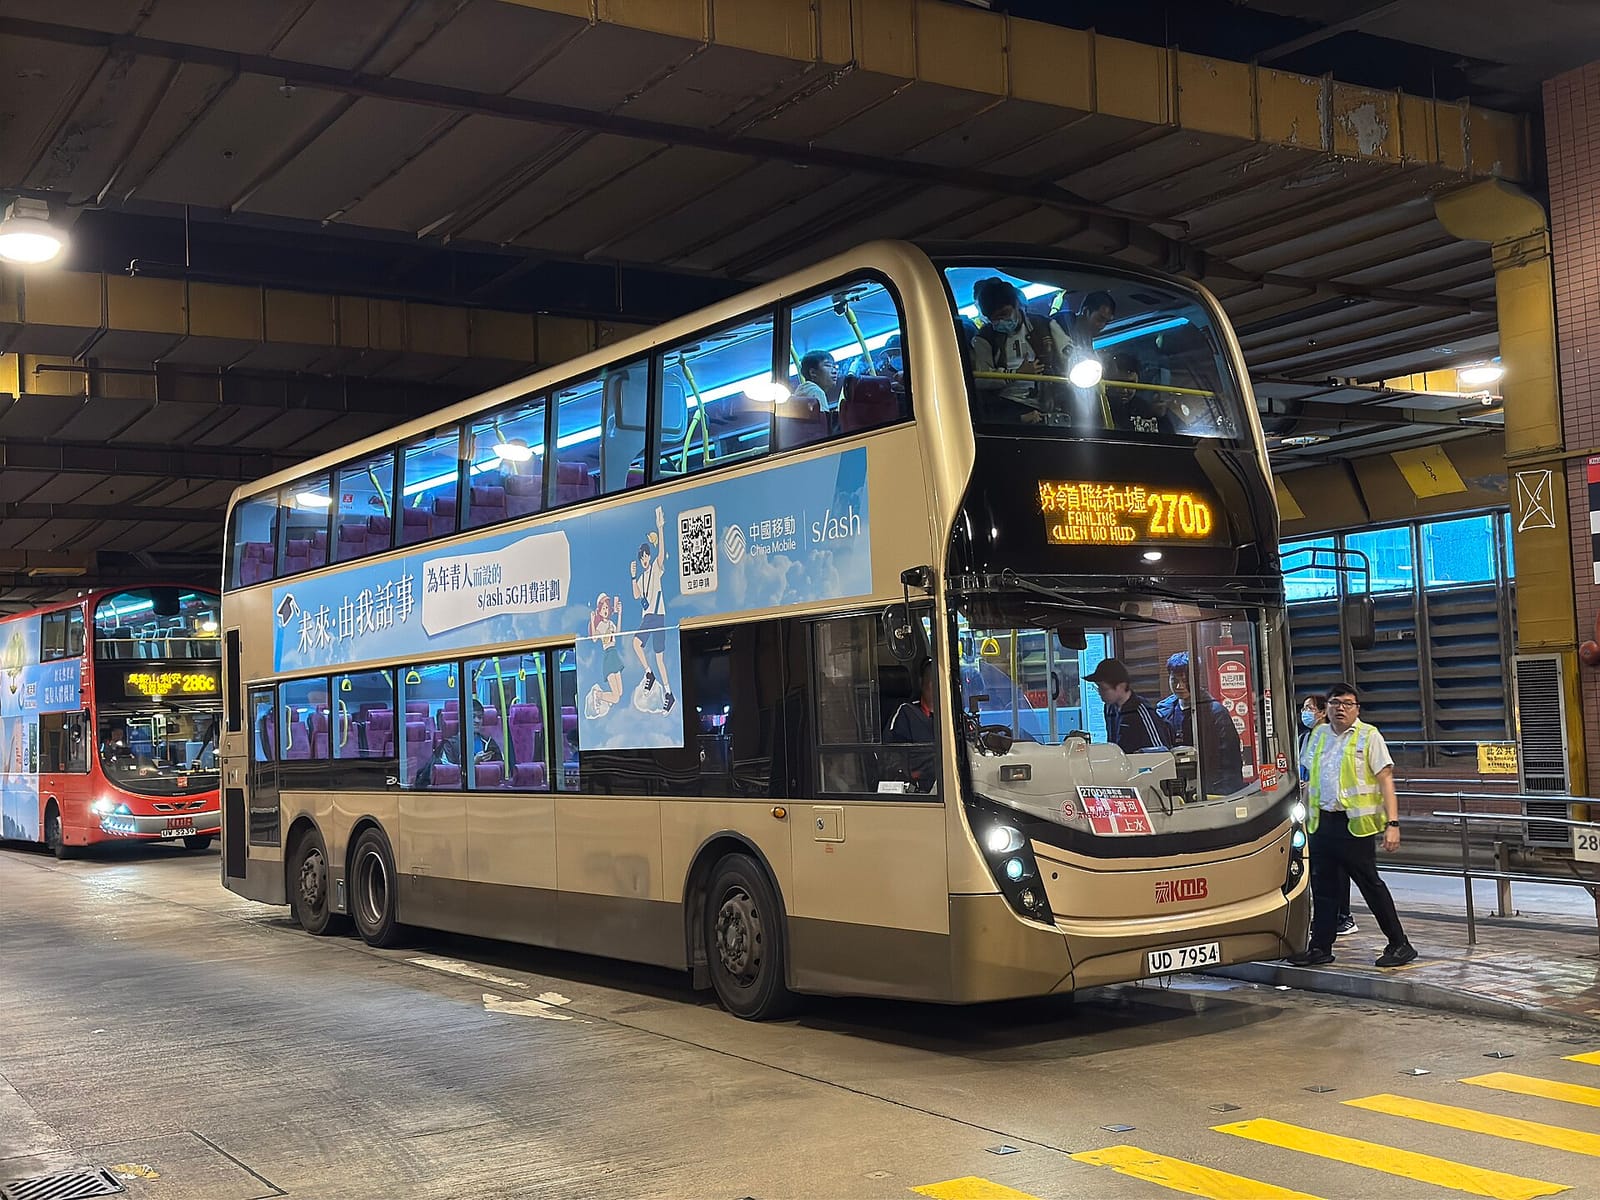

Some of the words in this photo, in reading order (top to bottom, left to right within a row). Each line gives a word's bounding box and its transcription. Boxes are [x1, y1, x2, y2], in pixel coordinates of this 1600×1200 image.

[1039, 483, 1148, 513] 粉嶺聯和墟
[1067, 511, 1117, 526] FANLING
[1148, 494, 1210, 534] 270D
[749, 515, 796, 541] 中國移動
[1092, 526, 1106, 540] WO
[750, 543, 771, 557] China
[772, 538, 796, 553] Mobile
[427, 562, 502, 593] 為年青人而設的
[505, 579, 561, 605] 5G月費計劃
[182, 674, 215, 691] 286C
[1487, 746, 1516, 755] 此公共
[1124, 819, 1146, 831] 上水
[1577, 834, 1600, 851] 28
[1170, 878, 1208, 902] KMB
[1152, 952, 1172, 970] UD
[1178, 945, 1217, 967] 7954
